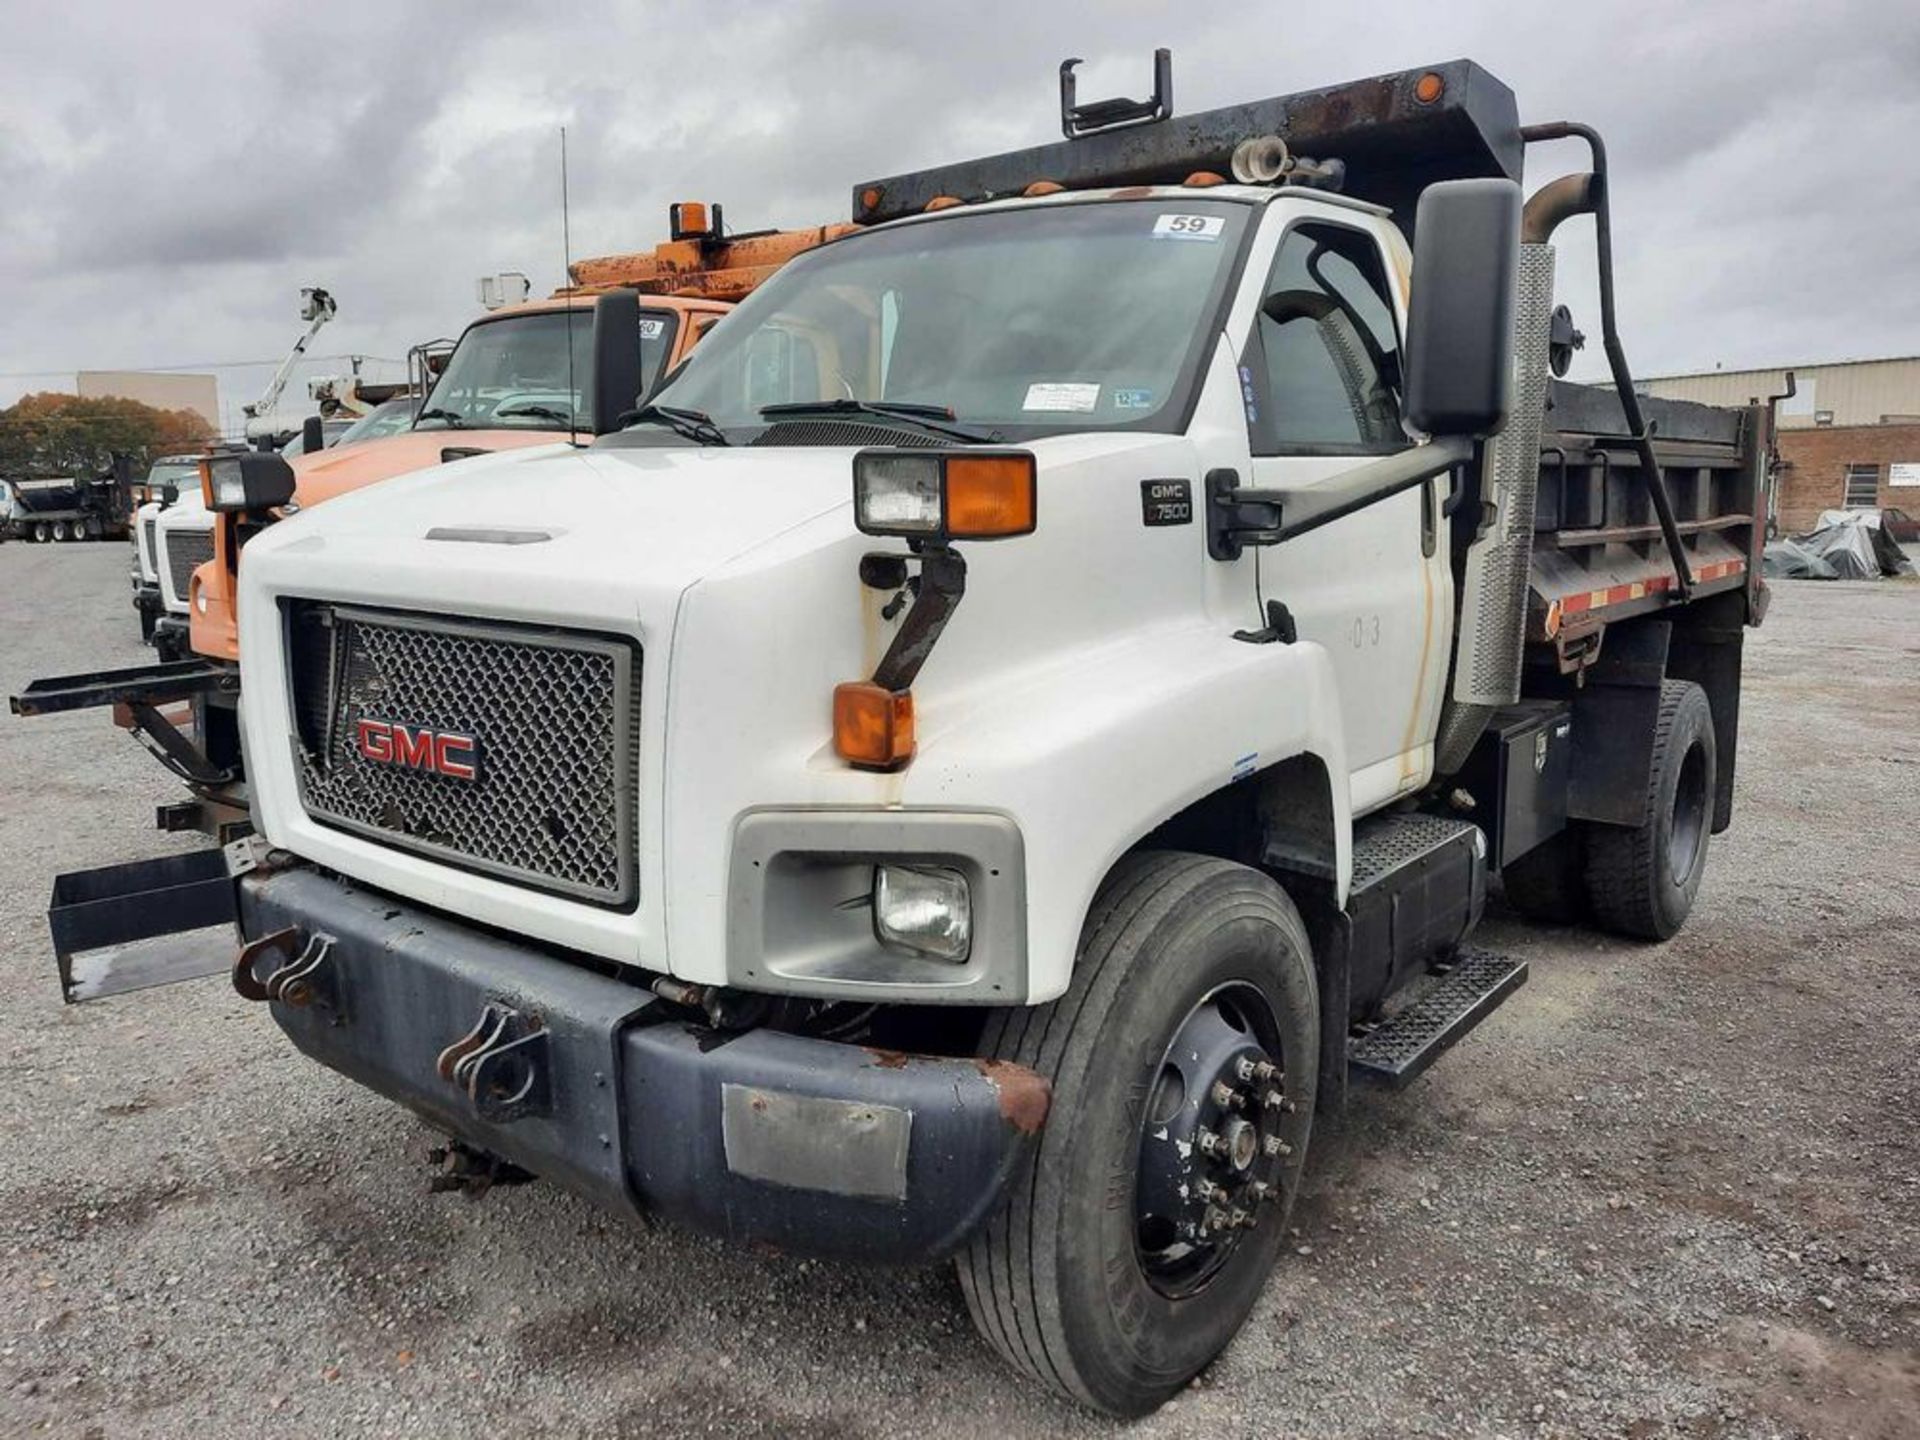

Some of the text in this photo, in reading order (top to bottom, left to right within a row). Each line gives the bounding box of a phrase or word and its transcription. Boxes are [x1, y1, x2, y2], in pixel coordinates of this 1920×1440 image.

[1169, 216, 1207, 233] 59
[1151, 485, 1184, 498] GMC
[358, 718, 476, 780] GMC
